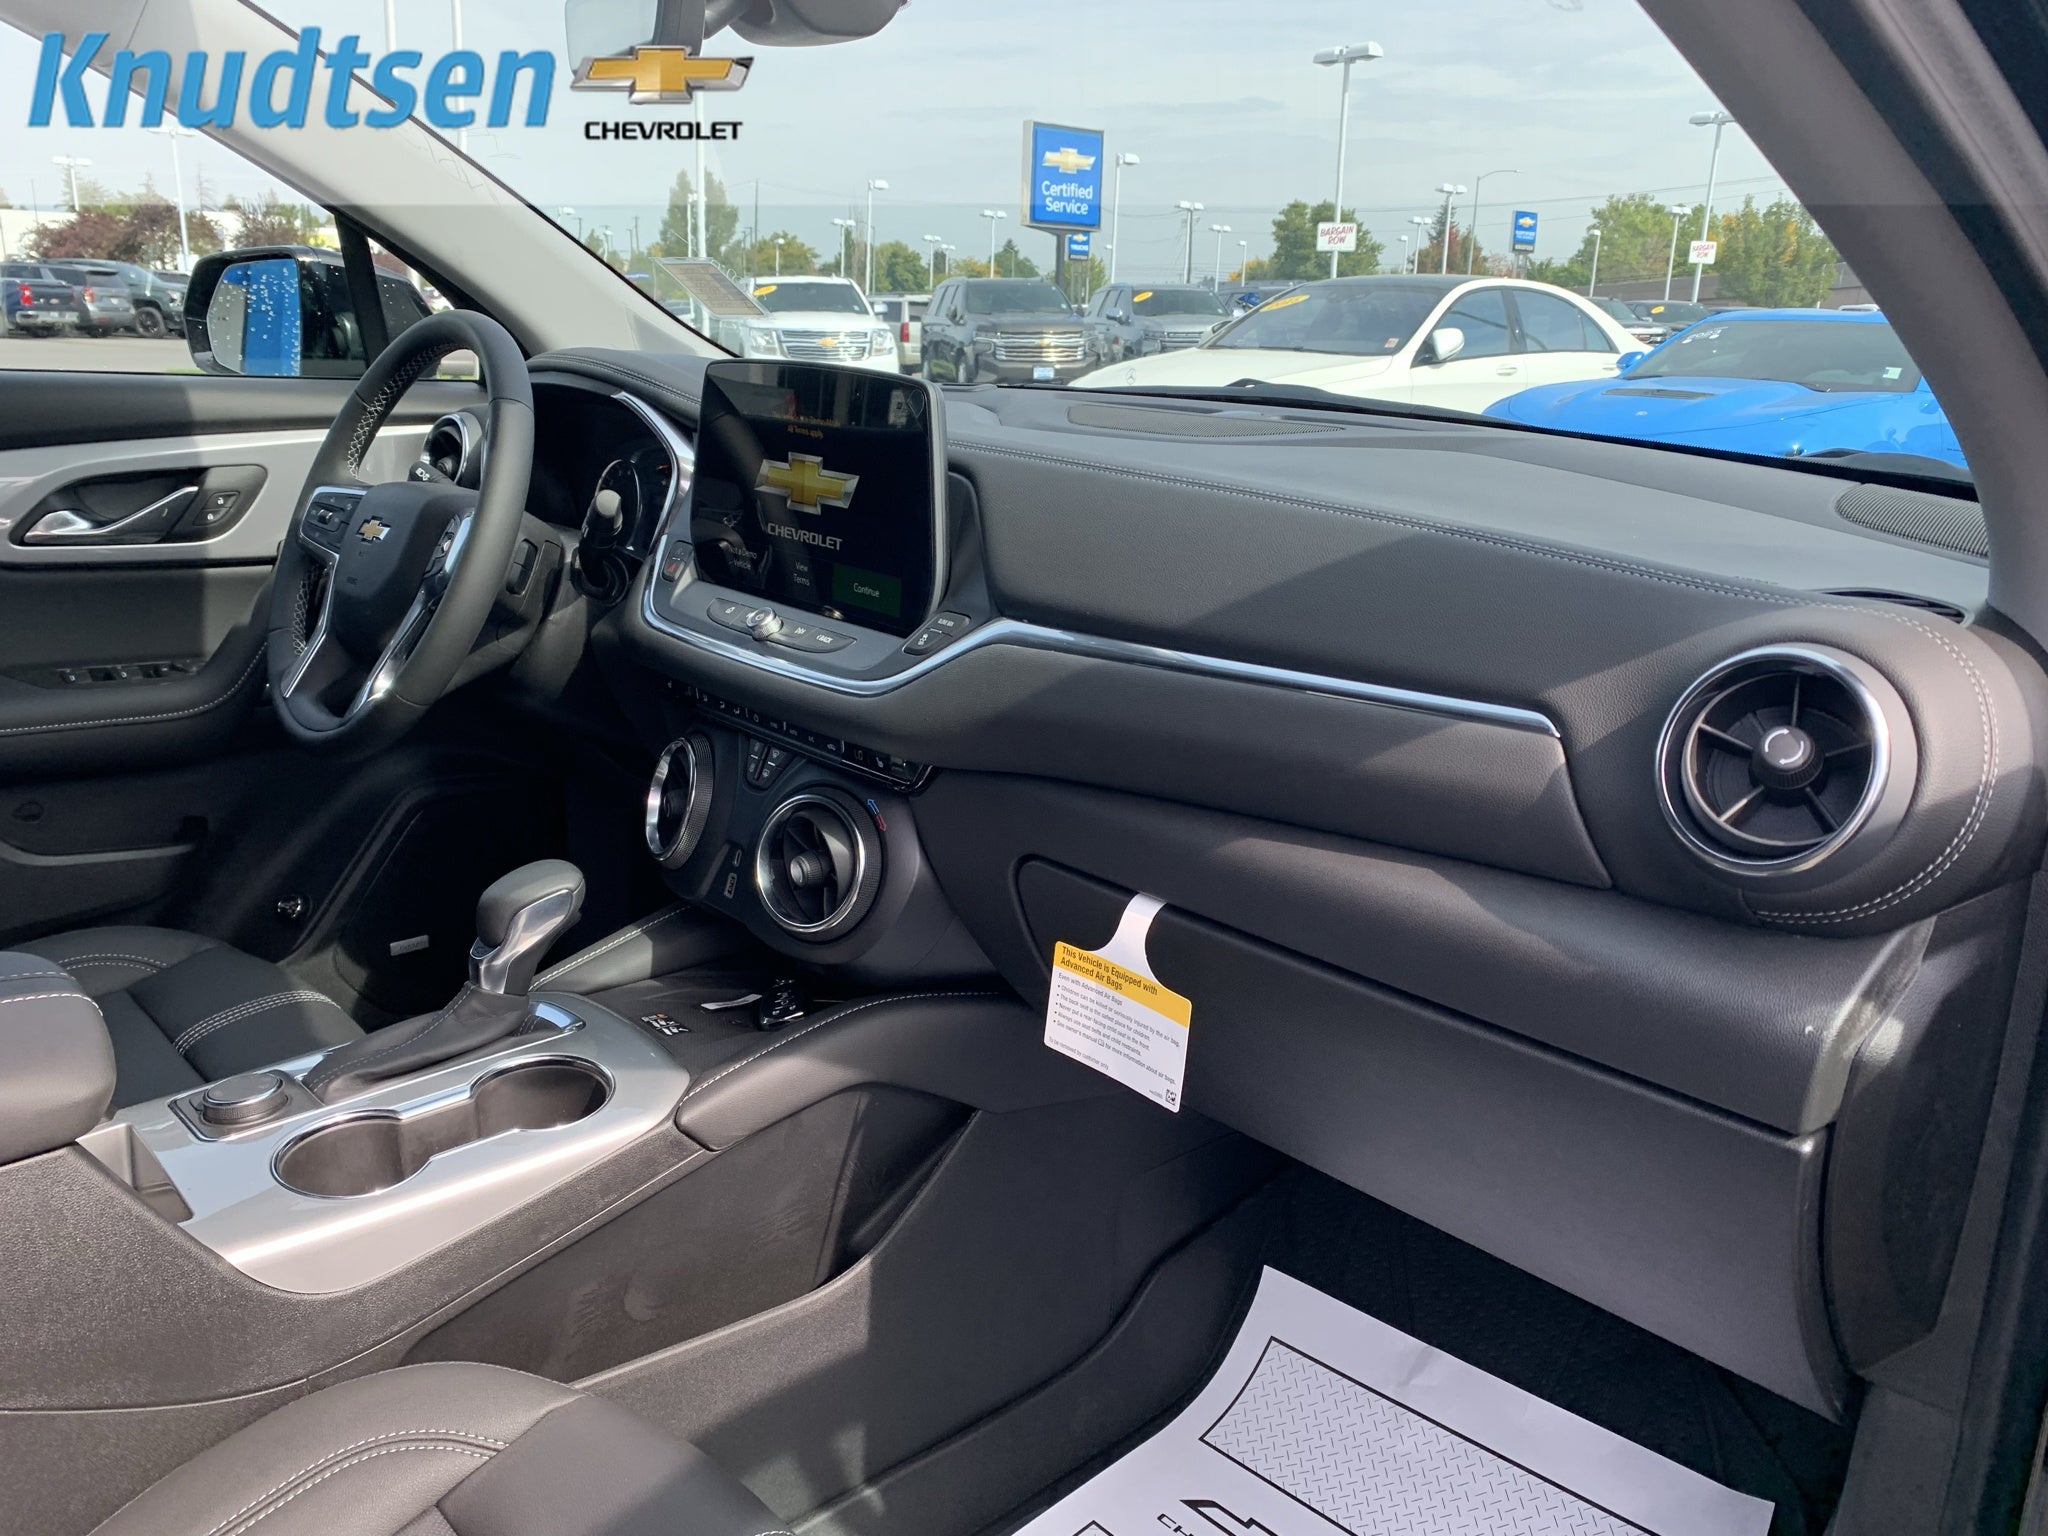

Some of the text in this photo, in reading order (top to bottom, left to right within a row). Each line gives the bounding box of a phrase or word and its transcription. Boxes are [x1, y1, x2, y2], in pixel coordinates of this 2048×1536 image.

[1041, 180, 1093, 199] Certified
[1045, 197, 1089, 215] Service
[1320, 226, 1354, 237] BARGAIN
[1328, 236, 1347, 245] ROW
[767, 523, 844, 551] CHEVROLET
[793, 573, 810, 586] Terms
[853, 582, 881, 598] Continue
[1061, 957, 1123, 991] Advanced Air Bags
[1062, 946, 1158, 995] This Vehicle is Equipped with
[1082, 982, 1103, 997] Advanced
